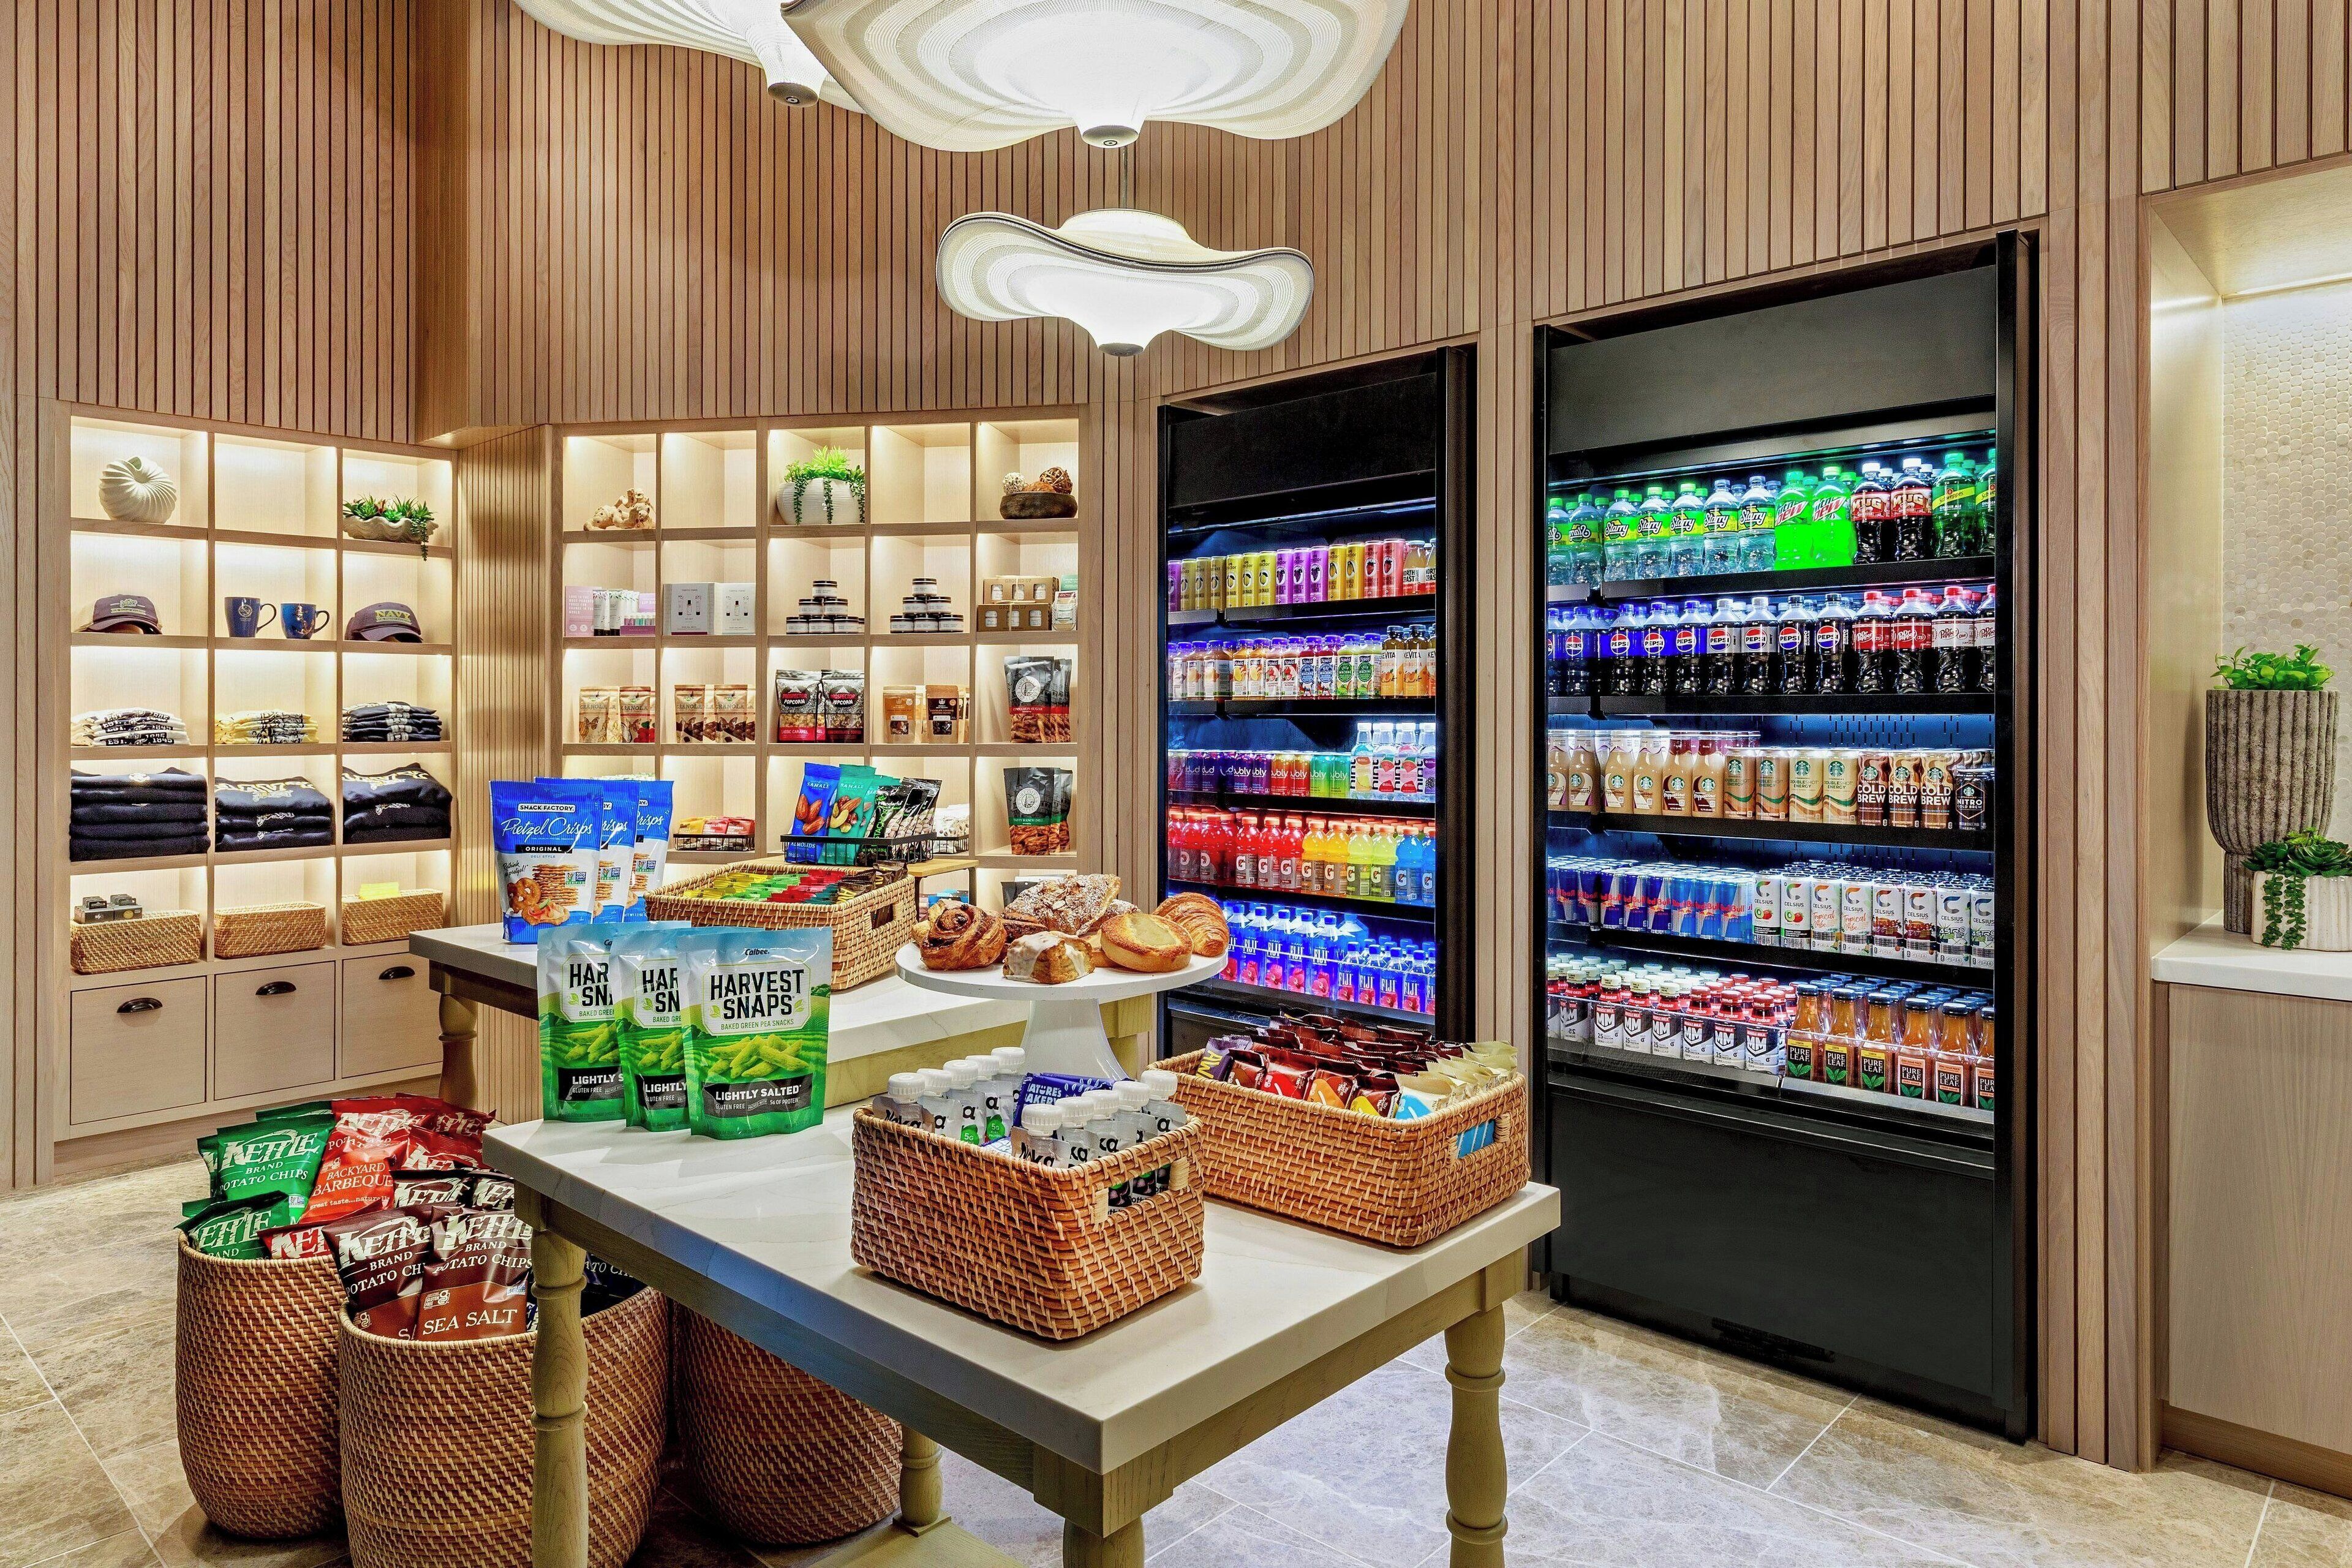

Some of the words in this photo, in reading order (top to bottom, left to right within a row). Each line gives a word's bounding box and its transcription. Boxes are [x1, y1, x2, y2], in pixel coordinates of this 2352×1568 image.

[1853, 498, 1882, 510] MUG
[1893, 494, 1923, 506] MUG
[1939, 491, 1964, 504] Schweppes
[1671, 516, 1695, 532] Starry
[1704, 512, 1728, 528] Starry
[1740, 509, 1766, 526] Starry
[1605, 522, 1629, 537] Starry
[1638, 519, 1662, 535] Starry
[376, 610, 410, 619] NAVY
[1858, 785, 1886, 794] COLD
[1889, 785, 1918, 795] COLD
[1921, 786, 1951, 796] COLD
[1858, 794, 1885, 803] BREW
[1889, 796, 1917, 804] BREW
[1921, 796, 1950, 805] BREW
[501, 818, 549, 842] Pretzel
[548, 816, 592, 843] Crisps
[1258, 859, 1268, 873] G
[1281, 860, 1292, 875] G
[1302, 862, 1311, 878] G
[1325, 865, 1334, 880] G
[1371, 867, 1381, 883] G
[1396, 870, 1406, 886] G
[1812, 910, 1835, 921] Tropical
[1842, 913, 1867, 924] Tropical
[1813, 919, 1828, 929] Vibe
[1844, 922, 1858, 932] Vibe
[1314, 949, 1329, 963] FIJI
[710, 969, 804, 1001] HARVEST
[1339, 971, 1352, 986] FIJI
[1360, 975, 1374, 989] FIJI
[1382, 979, 1396, 992] FIJI
[1404, 982, 1419, 995] FIJI
[723, 994, 793, 1020] SNAPS
[1624, 1016, 1642, 1034] MM
[1653, 1020, 1670, 1038] MM
[1684, 1026, 1702, 1044] MM
[1715, 1031, 1734, 1049] MM
[1747, 1036, 1766, 1054] MM
[1790, 1047, 1810, 1055] PURE
[1864, 1058, 1883, 1067] PURE
[1902, 1066, 1921, 1075] PURE
[572, 1074, 616, 1085] LIGHTLY
[645, 1082, 687, 1093] LIGHTLY
[715, 1090, 758, 1101] LIGHTLY
[761, 1085, 800, 1096] SALTED
[220, 1131, 320, 1172] KETTLE
[246, 1161, 283, 1174] BRAND
[327, 1163, 385, 1181] BACKYARD
[219, 1175, 265, 1192] POTATO
[270, 1169, 308, 1180] CHIPS
[312, 1174, 394, 1197] BARBEQUE
[466, 1242, 507, 1253] BRAND
[370, 1251, 413, 1271] BRAND
[432, 1254, 487, 1274] POTATO
[491, 1254, 532, 1269] CHIPS
[346, 1270, 397, 1295] POTATO
[423, 1318, 459, 1335] SEA
[466, 1309, 518, 1327] SALT
